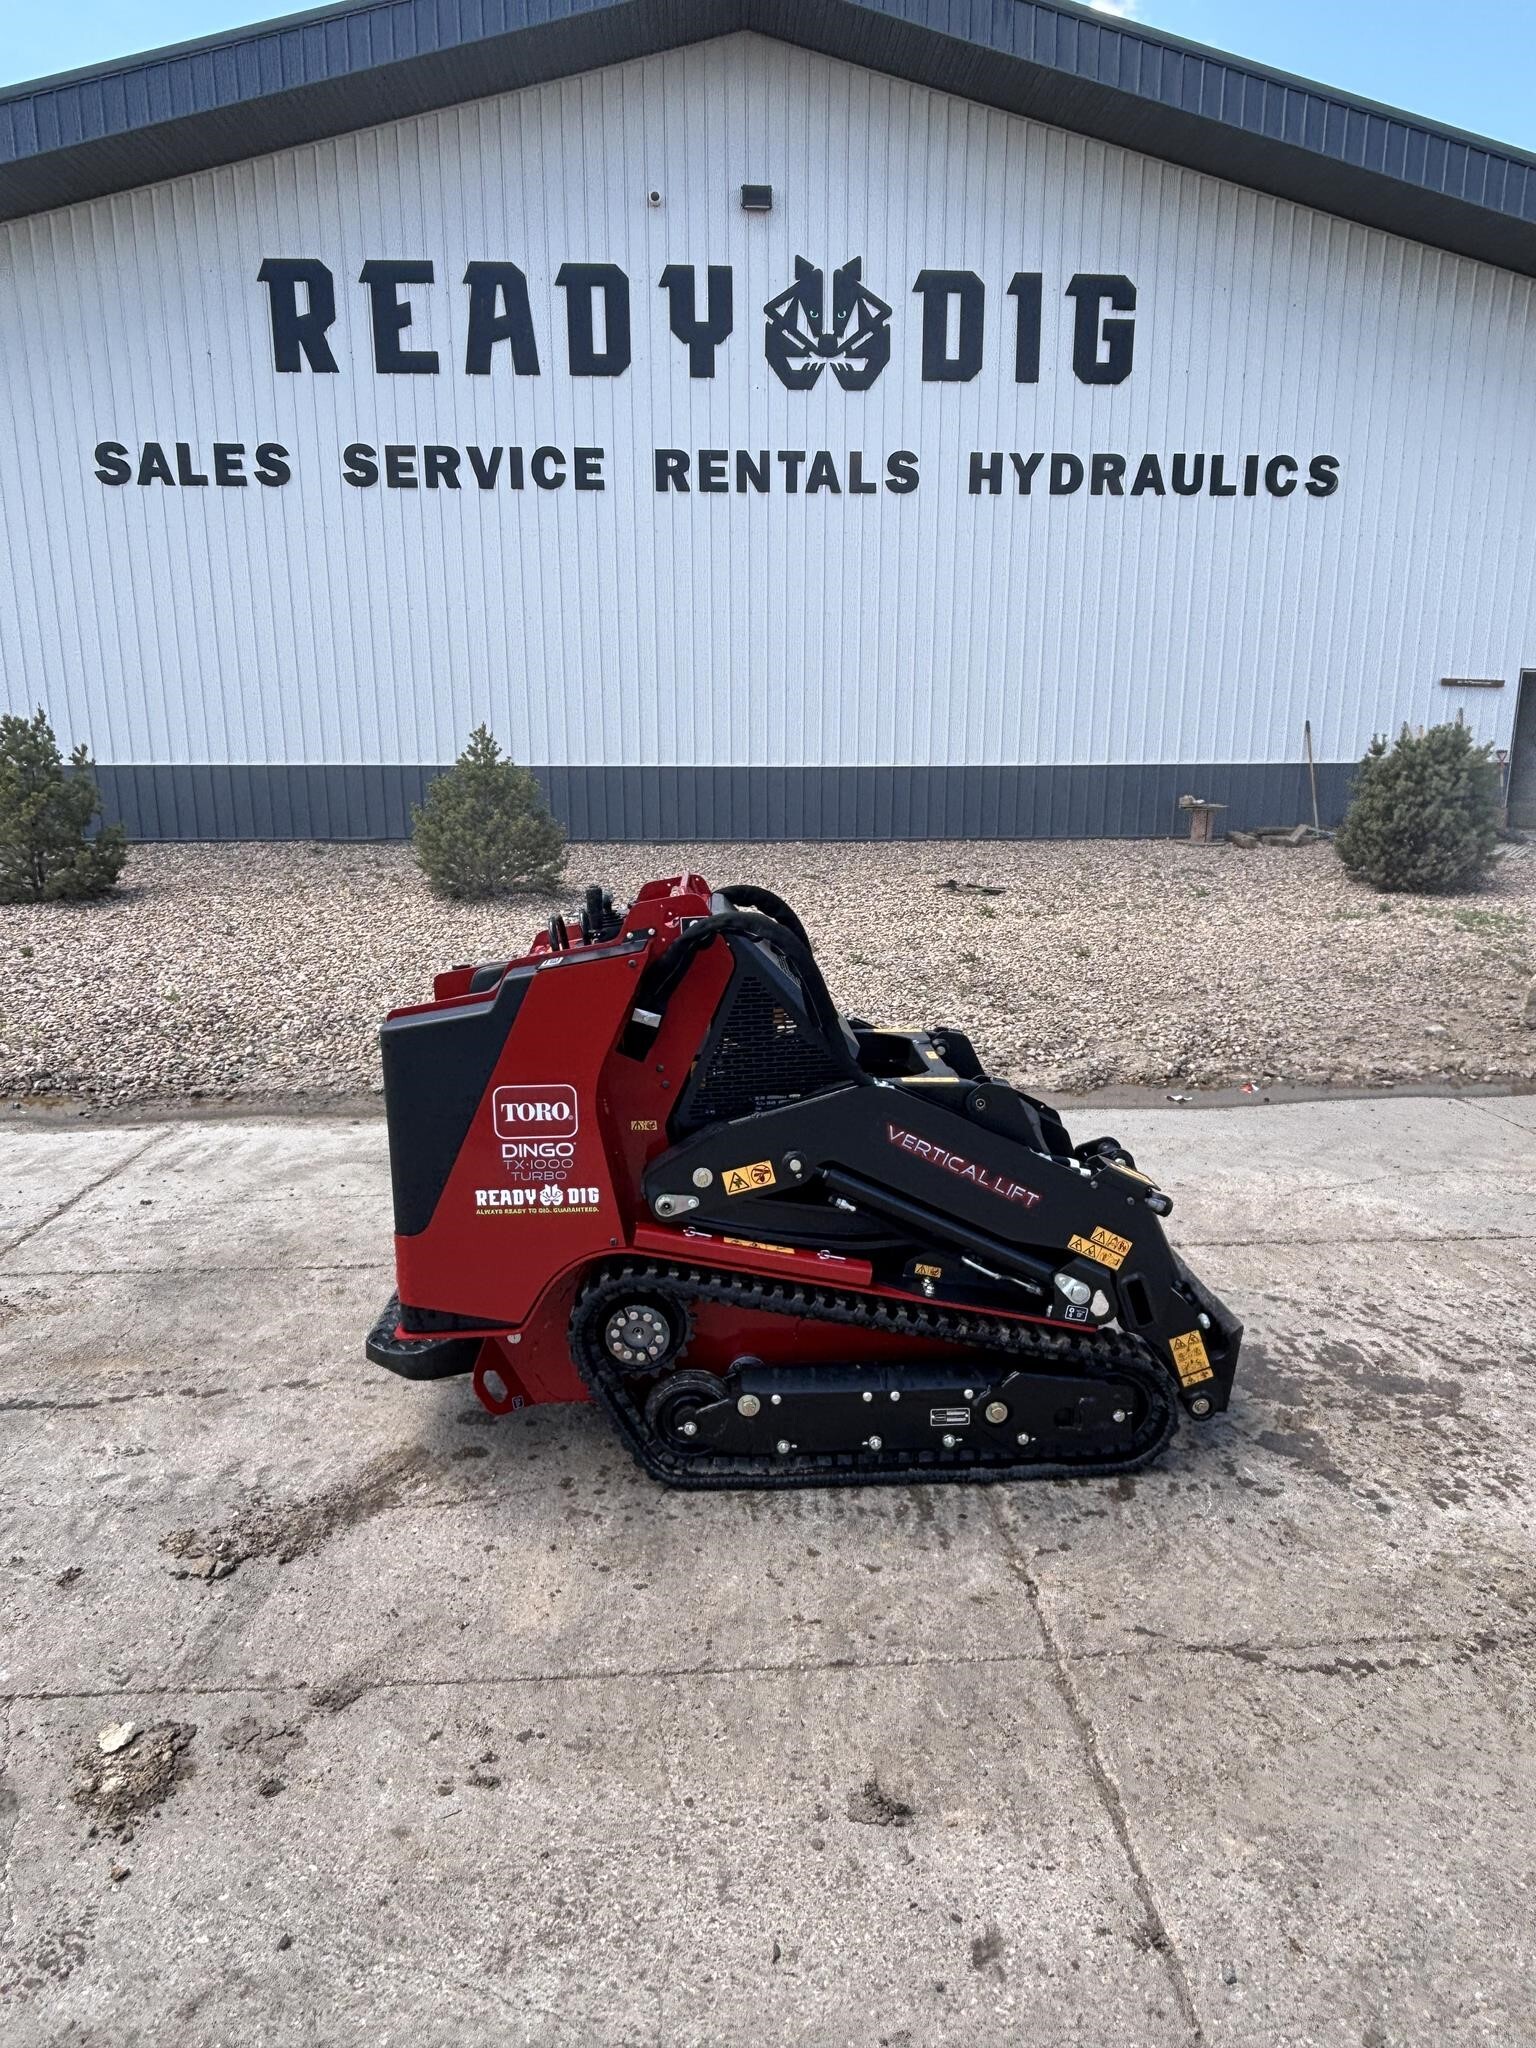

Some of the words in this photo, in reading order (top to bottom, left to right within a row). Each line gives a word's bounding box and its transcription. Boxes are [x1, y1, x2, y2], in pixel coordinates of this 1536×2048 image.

[257, 258, 733, 378] READY
[95, 442, 290, 487] SALES
[342, 443, 604, 491] SERVICE
[655, 449, 919, 494] RENTALS
[969, 452, 1339, 497] HYDRAULICS
[501, 1102, 571, 1122] TORO
[502, 1143, 575, 1158] DINGO
[886, 1125, 989, 1187] VERTICAL
[994, 1177, 1040, 1206] LIFT
[512, 1171, 567, 1181] TURBO
[475, 1189, 537, 1206] READY
[567, 1187, 600, 1204] DIG
